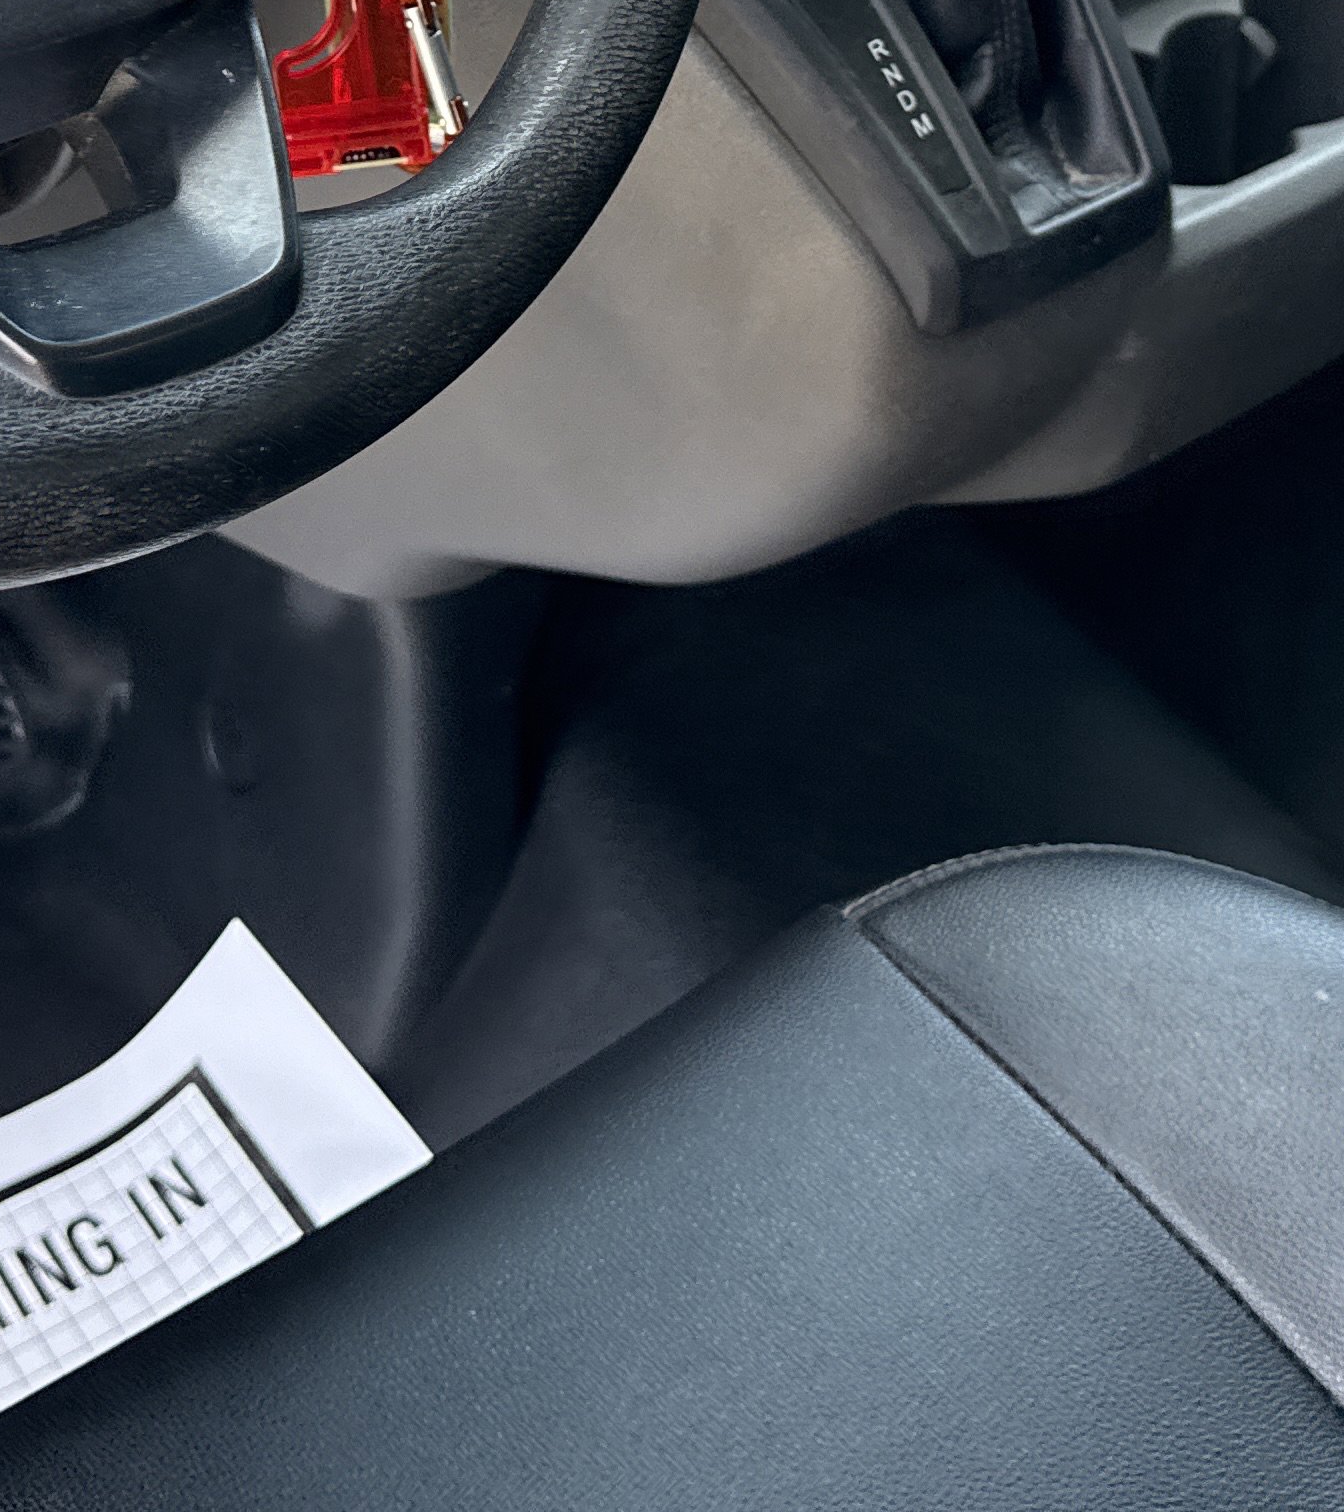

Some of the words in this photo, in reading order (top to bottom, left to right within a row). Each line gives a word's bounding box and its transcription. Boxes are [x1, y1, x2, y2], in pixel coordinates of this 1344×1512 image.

[866, 37, 891, 63] R
[880, 62, 906, 88] N
[896, 88, 919, 113] D
[909, 111, 937, 139] M
[126, 1155, 209, 1242] IN
